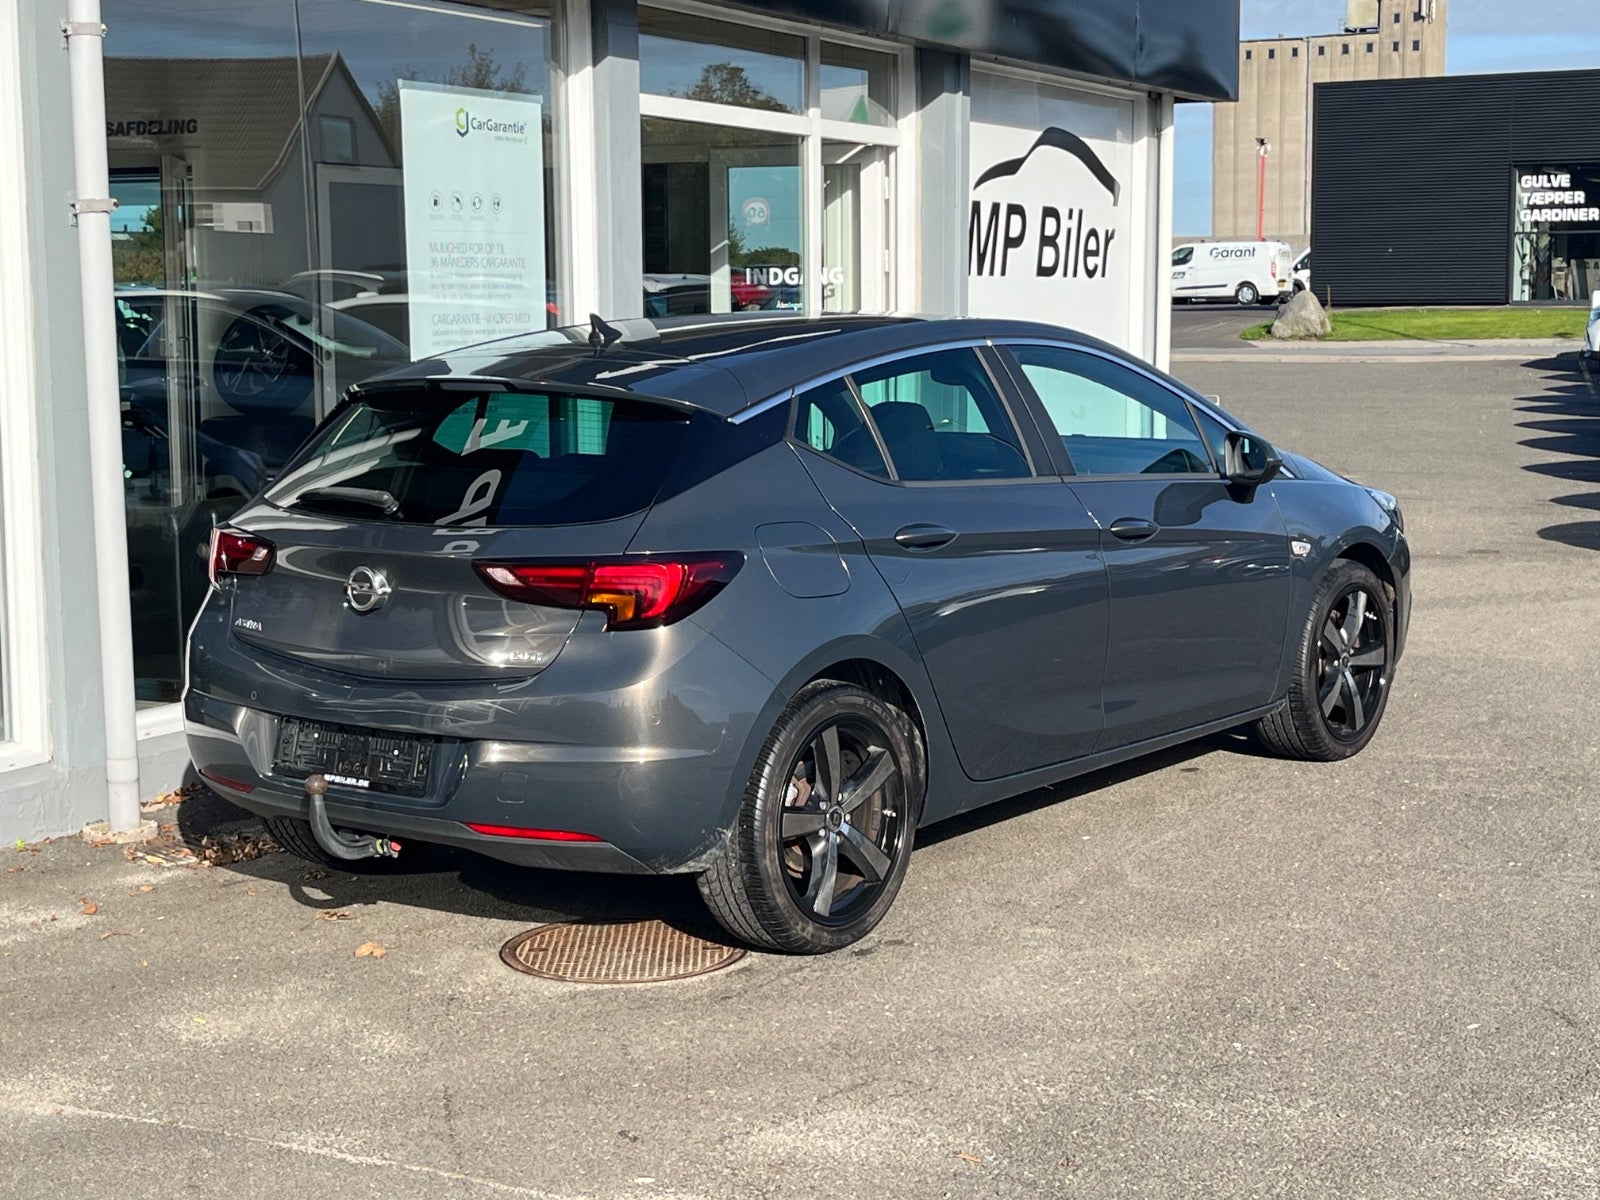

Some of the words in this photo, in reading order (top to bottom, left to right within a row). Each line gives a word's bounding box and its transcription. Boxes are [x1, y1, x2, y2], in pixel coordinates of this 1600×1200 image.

[471, 117, 525, 135] CarGarantie
[1520, 174, 1571, 188] GULVE
[1520, 190, 1586, 205] TÆPPER
[1520, 207, 1600, 222] GARDINER
[968, 200, 1027, 277] MP
[1036, 206, 1116, 279] Biler
[1209, 247, 1256, 258] Garant
